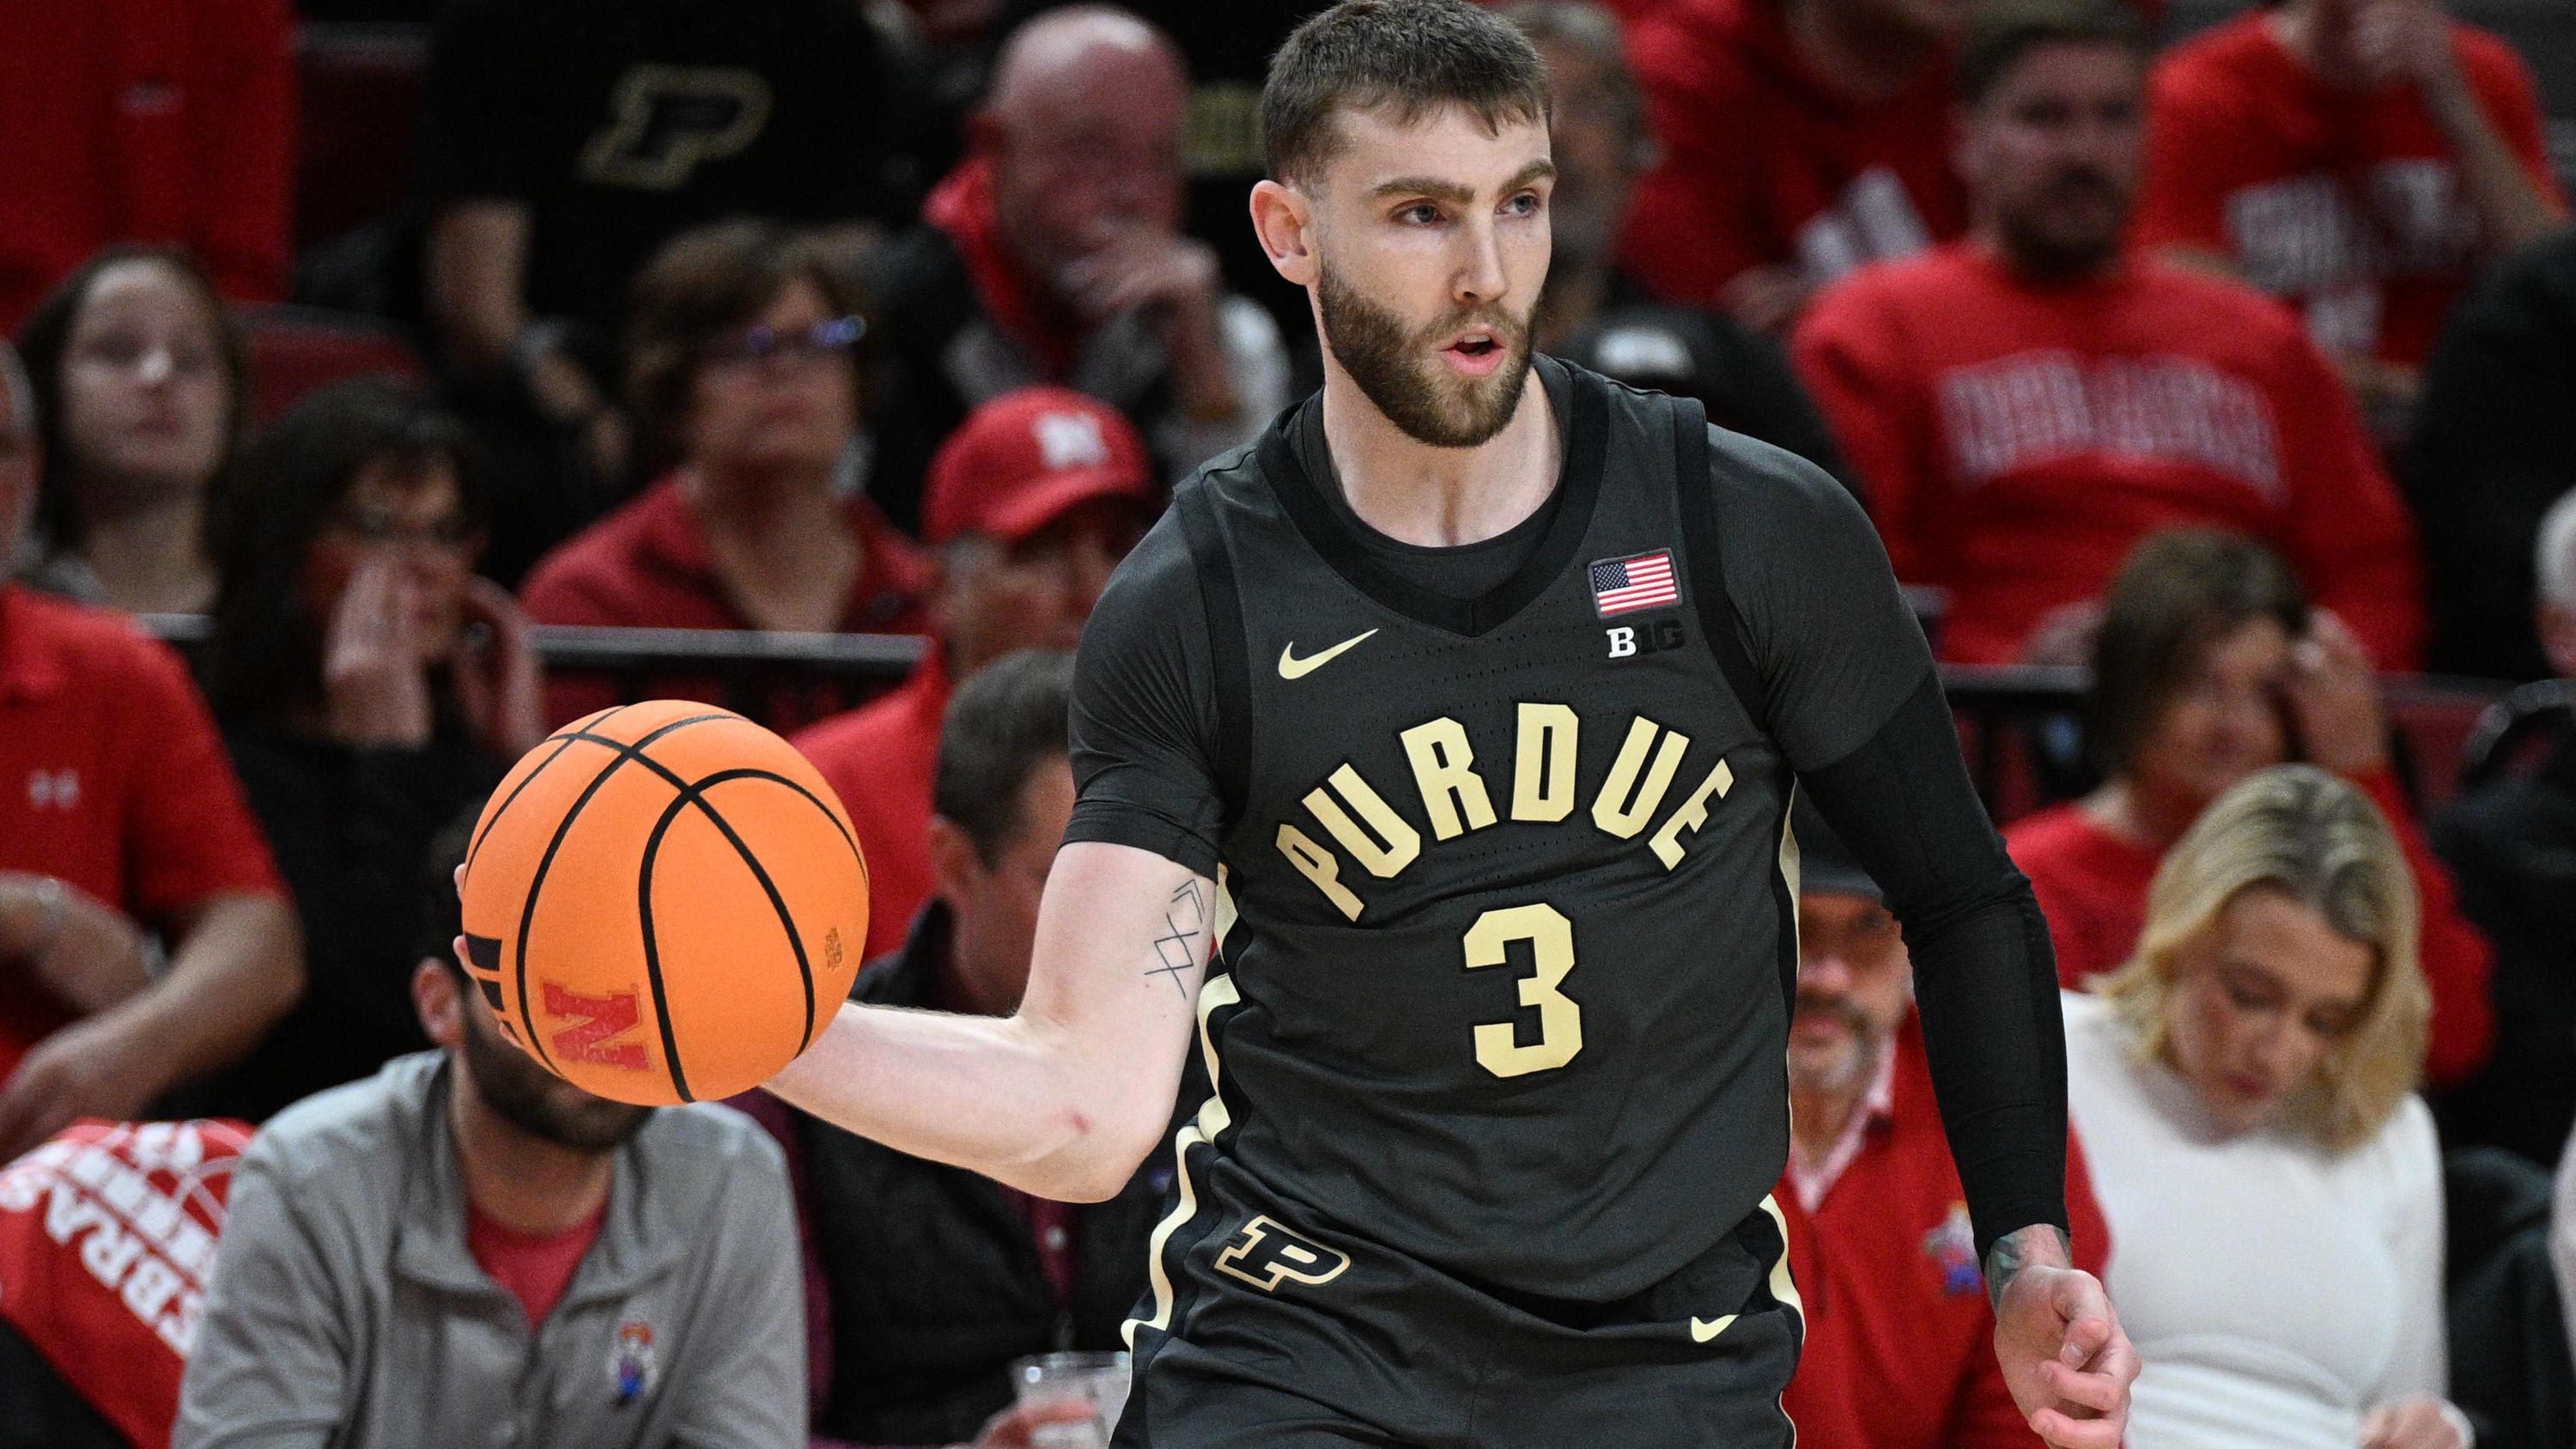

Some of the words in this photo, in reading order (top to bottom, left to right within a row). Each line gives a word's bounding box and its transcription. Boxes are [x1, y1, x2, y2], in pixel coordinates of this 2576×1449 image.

[577, 62, 773, 192] P
[1275, 702, 1734, 922] PURDUE
[541, 981, 653, 1072] N
[1462, 903, 1583, 1078] 3
[1214, 1214, 1351, 1292] P
